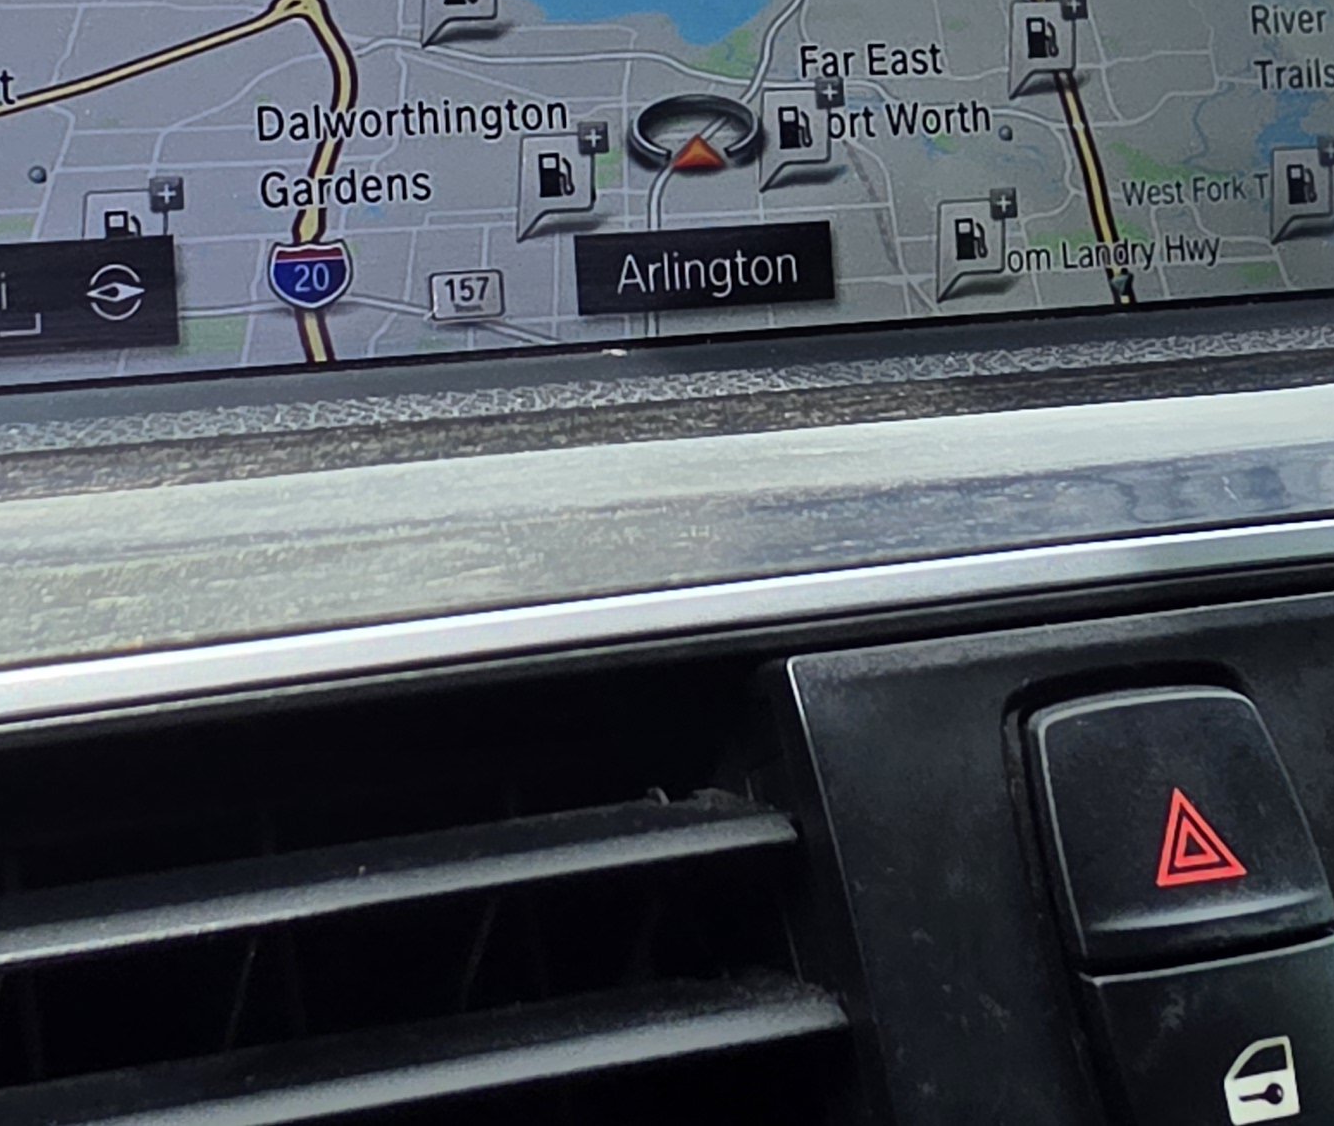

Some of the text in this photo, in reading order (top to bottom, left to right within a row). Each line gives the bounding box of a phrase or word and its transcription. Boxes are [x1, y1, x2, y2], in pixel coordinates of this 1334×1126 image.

[1252, 4, 1328, 35] River
[801, 42, 944, 78] Far East
[256, 99, 569, 142] Dalworthington
[886, 101, 992, 136] Worth
[260, 169, 433, 209] Gardens
[1122, 179, 1185, 207] West
[1192, 175, 1247, 202] Fork
[1062, 239, 1156, 271] Landry
[1165, 234, 1220, 267] Hwy
[293, 264, 331, 294] 20
[444, 276, 490, 303] 157
[617, 250, 799, 299] Arlington
